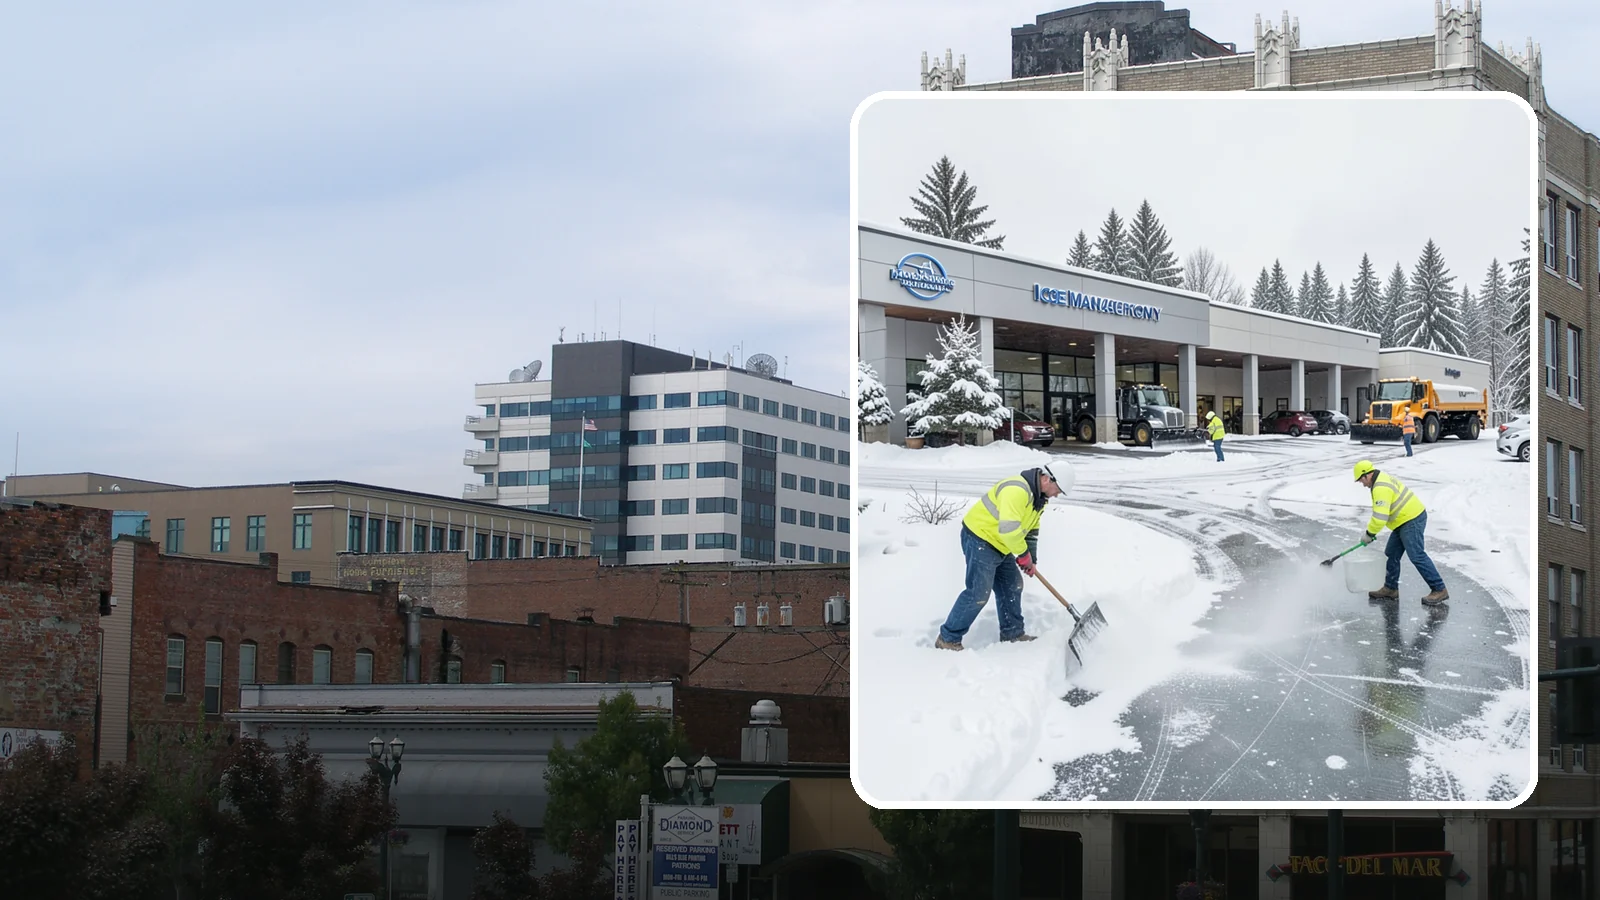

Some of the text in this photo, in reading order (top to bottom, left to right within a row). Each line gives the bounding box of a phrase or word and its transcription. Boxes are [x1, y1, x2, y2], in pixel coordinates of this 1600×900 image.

[370, 566, 427, 576] Furnishers
[660, 818, 713, 832] DIAMOND
[1022, 815, 1069, 827] BUILDING
[616, 825, 625, 893] PAY HERE
[627, 824, 637, 893] PAY HERE
[671, 861, 701, 870] PATRONS
[1346, 856, 1385, 875] DEL
[1391, 857, 1443, 877] MAR
[660, 888, 710, 898] PUBLIC PARKING
